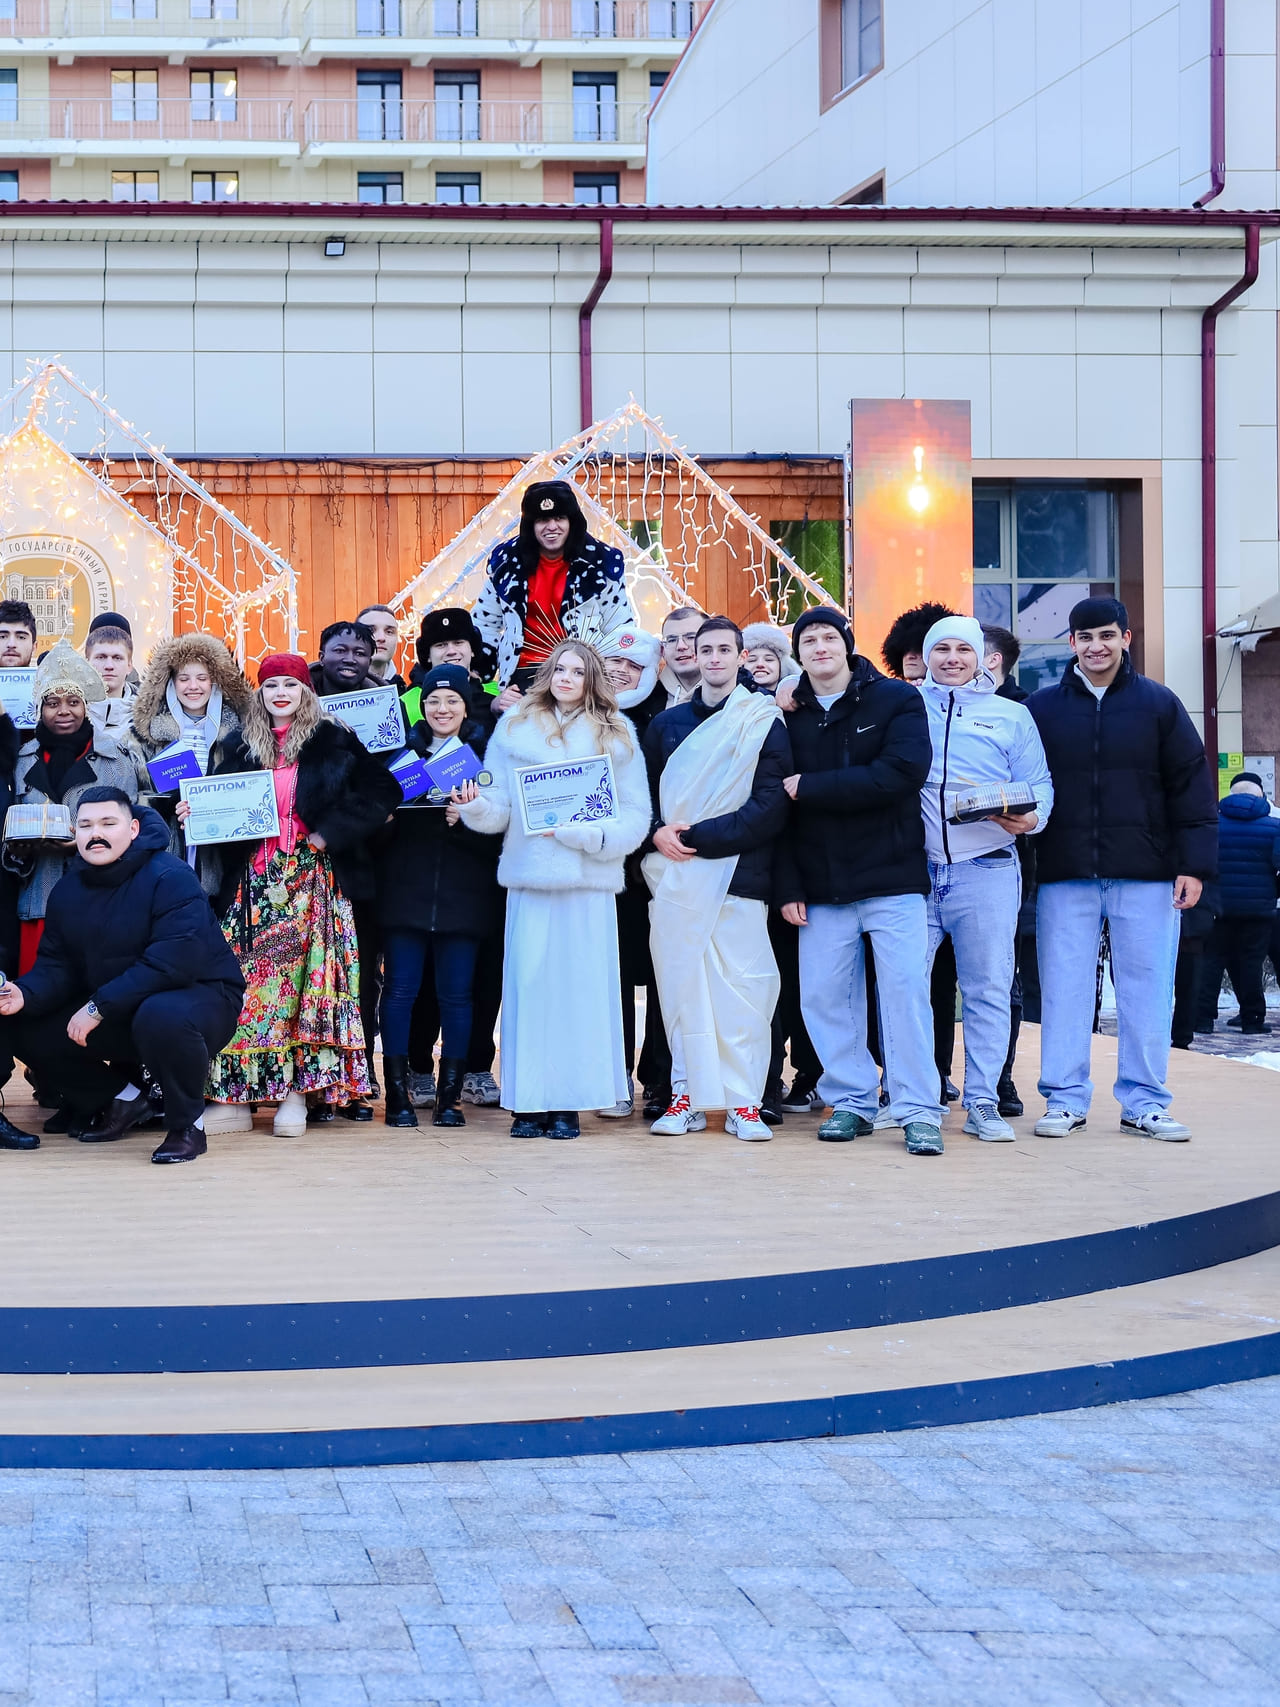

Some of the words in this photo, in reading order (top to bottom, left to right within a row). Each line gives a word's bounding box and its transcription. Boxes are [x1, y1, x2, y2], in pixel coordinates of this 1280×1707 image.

[8, 541, 104, 576] ГОСУДАРСТВЕННЫЙ
[96, 581, 109, 611] АГРАР
[327, 697, 375, 713] ДИПЛОМ
[524, 767, 583, 784] ДИПЛОМ
[188, 781, 246, 795] ДИПЛОМ
